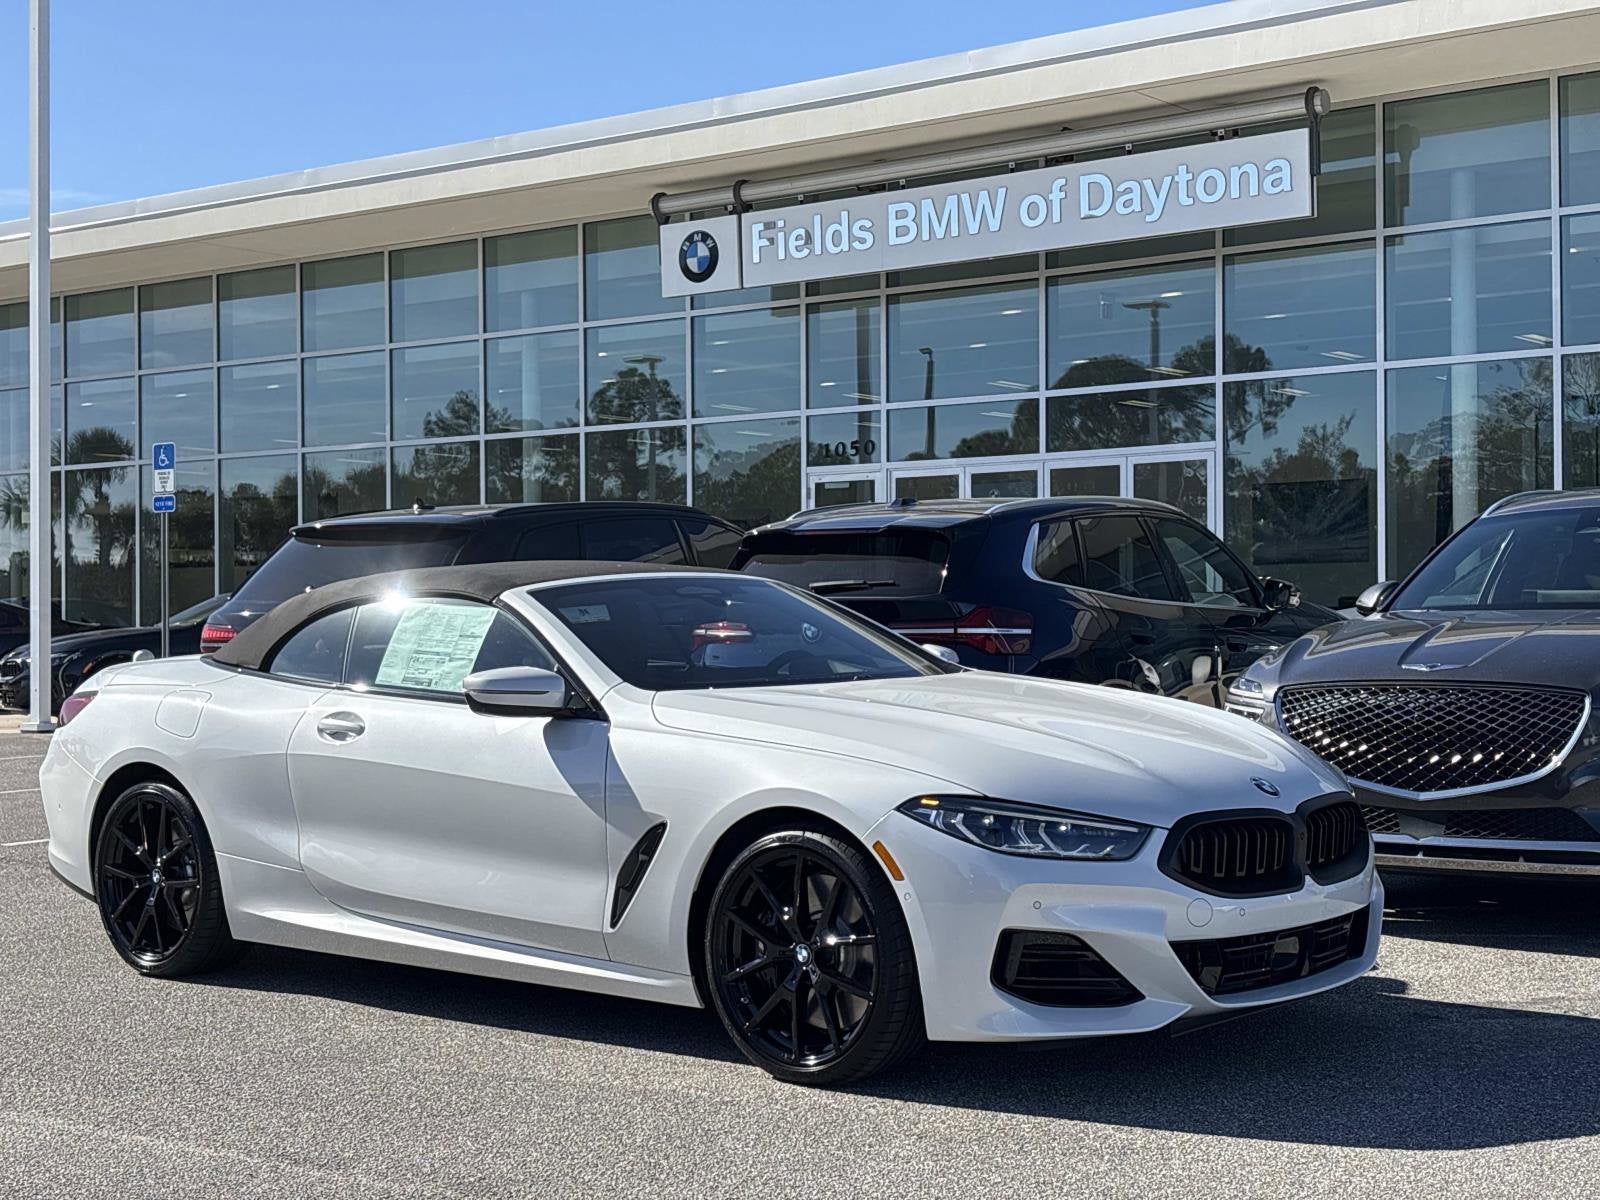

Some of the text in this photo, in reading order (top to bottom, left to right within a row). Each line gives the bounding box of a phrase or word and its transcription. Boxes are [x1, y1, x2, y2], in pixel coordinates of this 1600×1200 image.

[751, 158, 1293, 264] Fields BMW of Daytona
[682, 233, 716, 251] BMW
[823, 440, 876, 458] 1050
